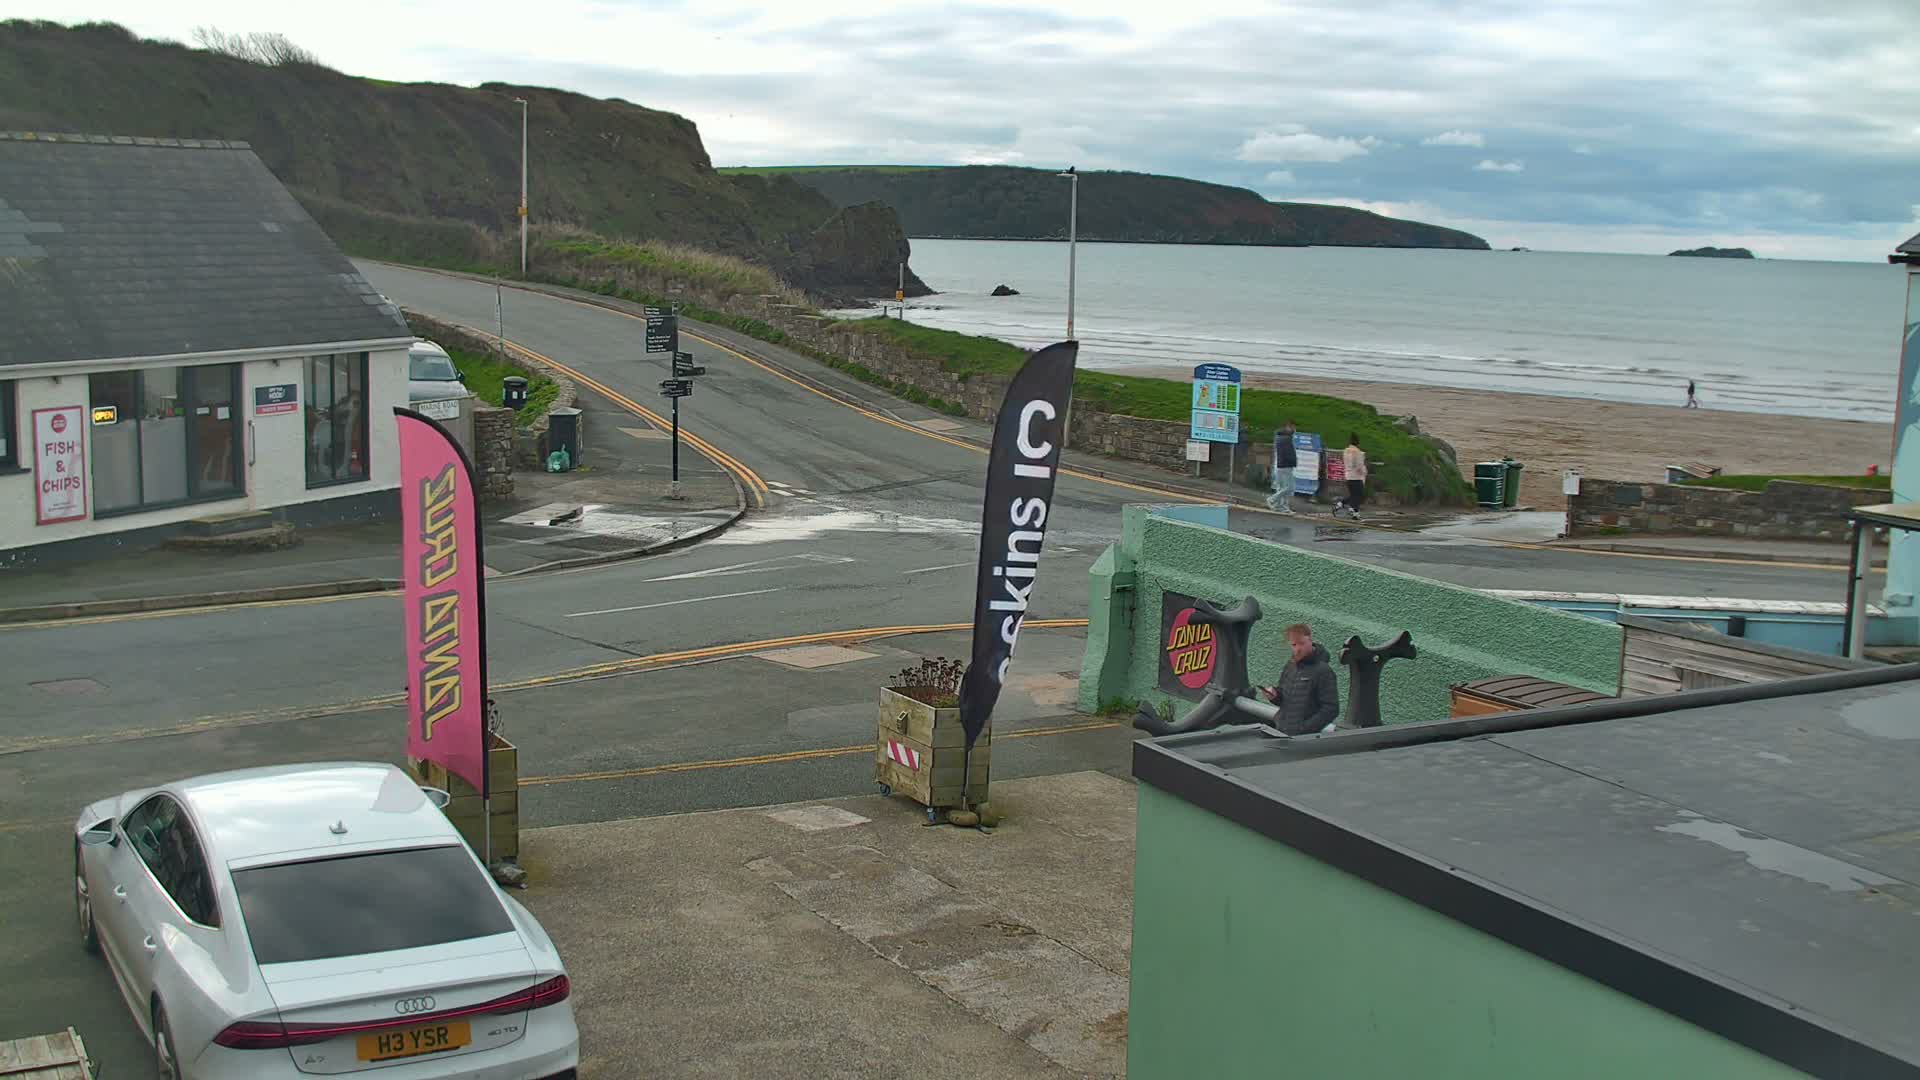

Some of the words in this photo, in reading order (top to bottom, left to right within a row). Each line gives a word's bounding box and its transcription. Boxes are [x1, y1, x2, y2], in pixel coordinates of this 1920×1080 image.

[94, 411, 114, 421] OPEN
[46, 440, 75, 457] FISH
[56, 459, 66, 473] &
[42, 475, 81, 494] CHIPS
[1166, 624, 1212, 652] SANTA
[1174, 645, 1212, 675] CRUZ
[378, 1032, 404, 1055] H3
[406, 1026, 449, 1050] YSR
